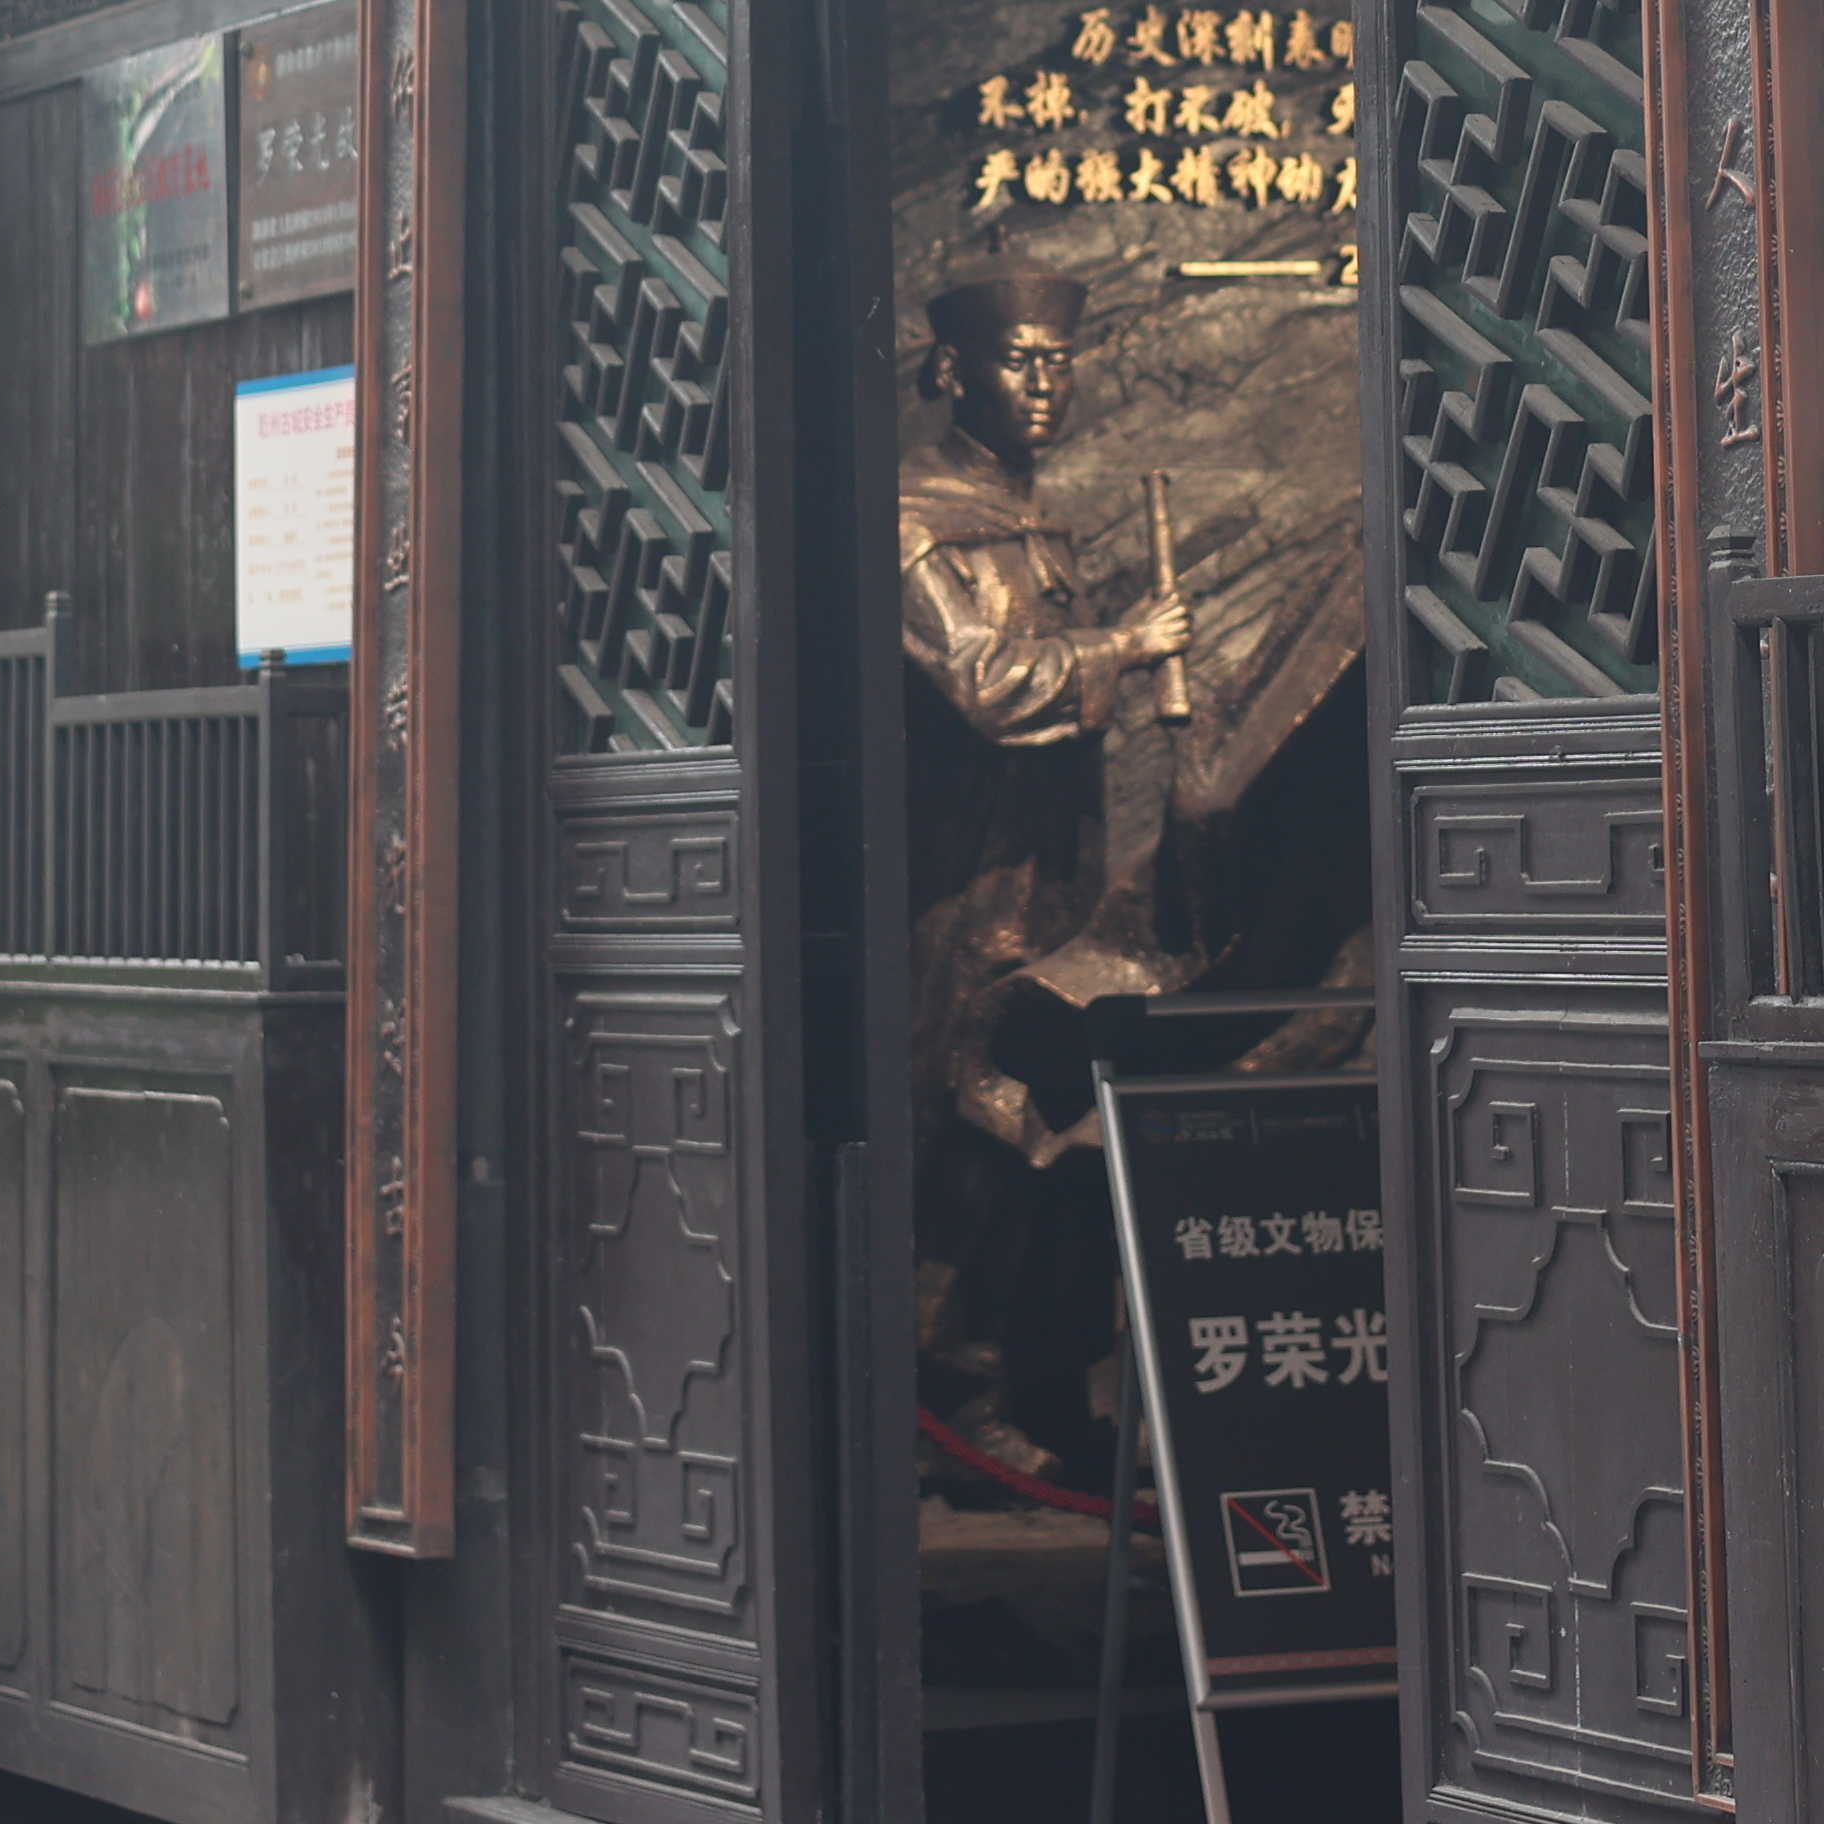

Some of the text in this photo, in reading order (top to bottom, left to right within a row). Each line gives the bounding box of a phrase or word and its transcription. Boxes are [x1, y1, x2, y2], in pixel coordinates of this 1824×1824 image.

[1175, 1209, 1384, 1260] 省级文物保
[1189, 1309, 1389, 1393] 罗荣光
